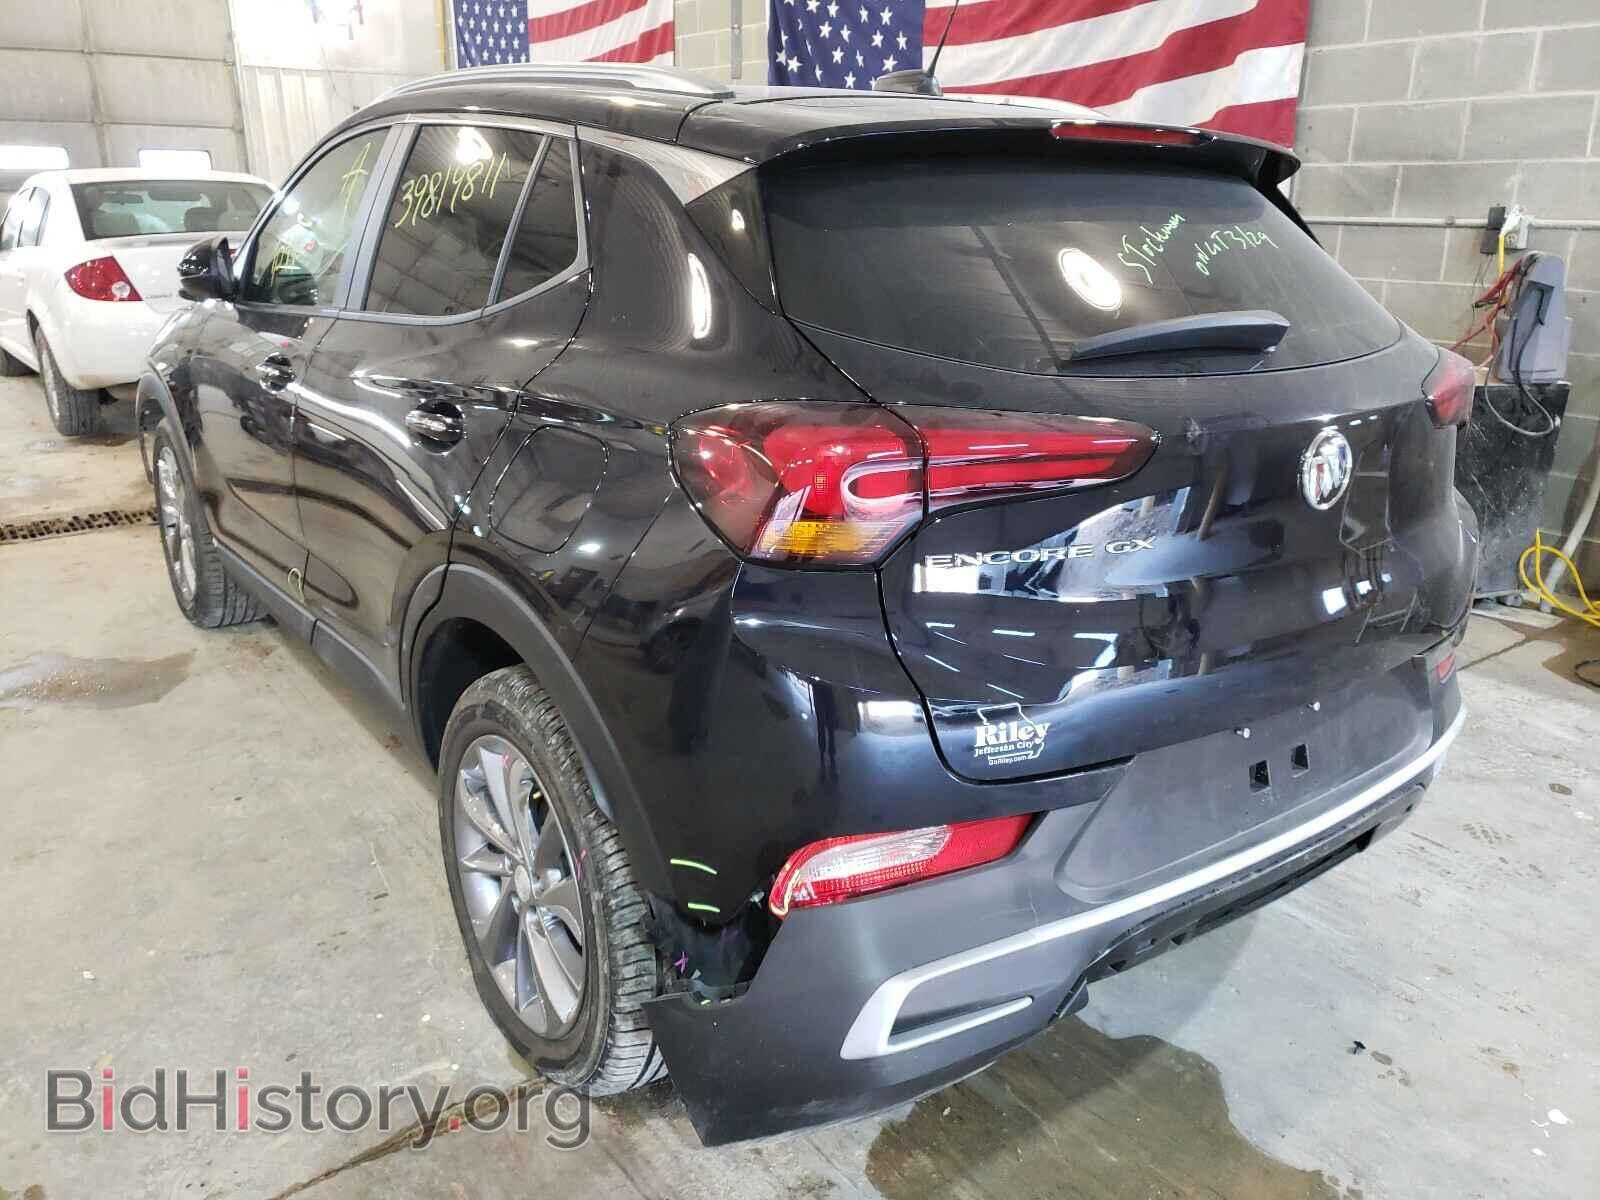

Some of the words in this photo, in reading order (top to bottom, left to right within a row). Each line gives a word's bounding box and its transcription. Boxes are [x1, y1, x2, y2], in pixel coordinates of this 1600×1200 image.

[924, 543, 1095, 568] ENCORE
[1104, 536, 1156, 555] GX
[973, 721, 1052, 748] Riley
